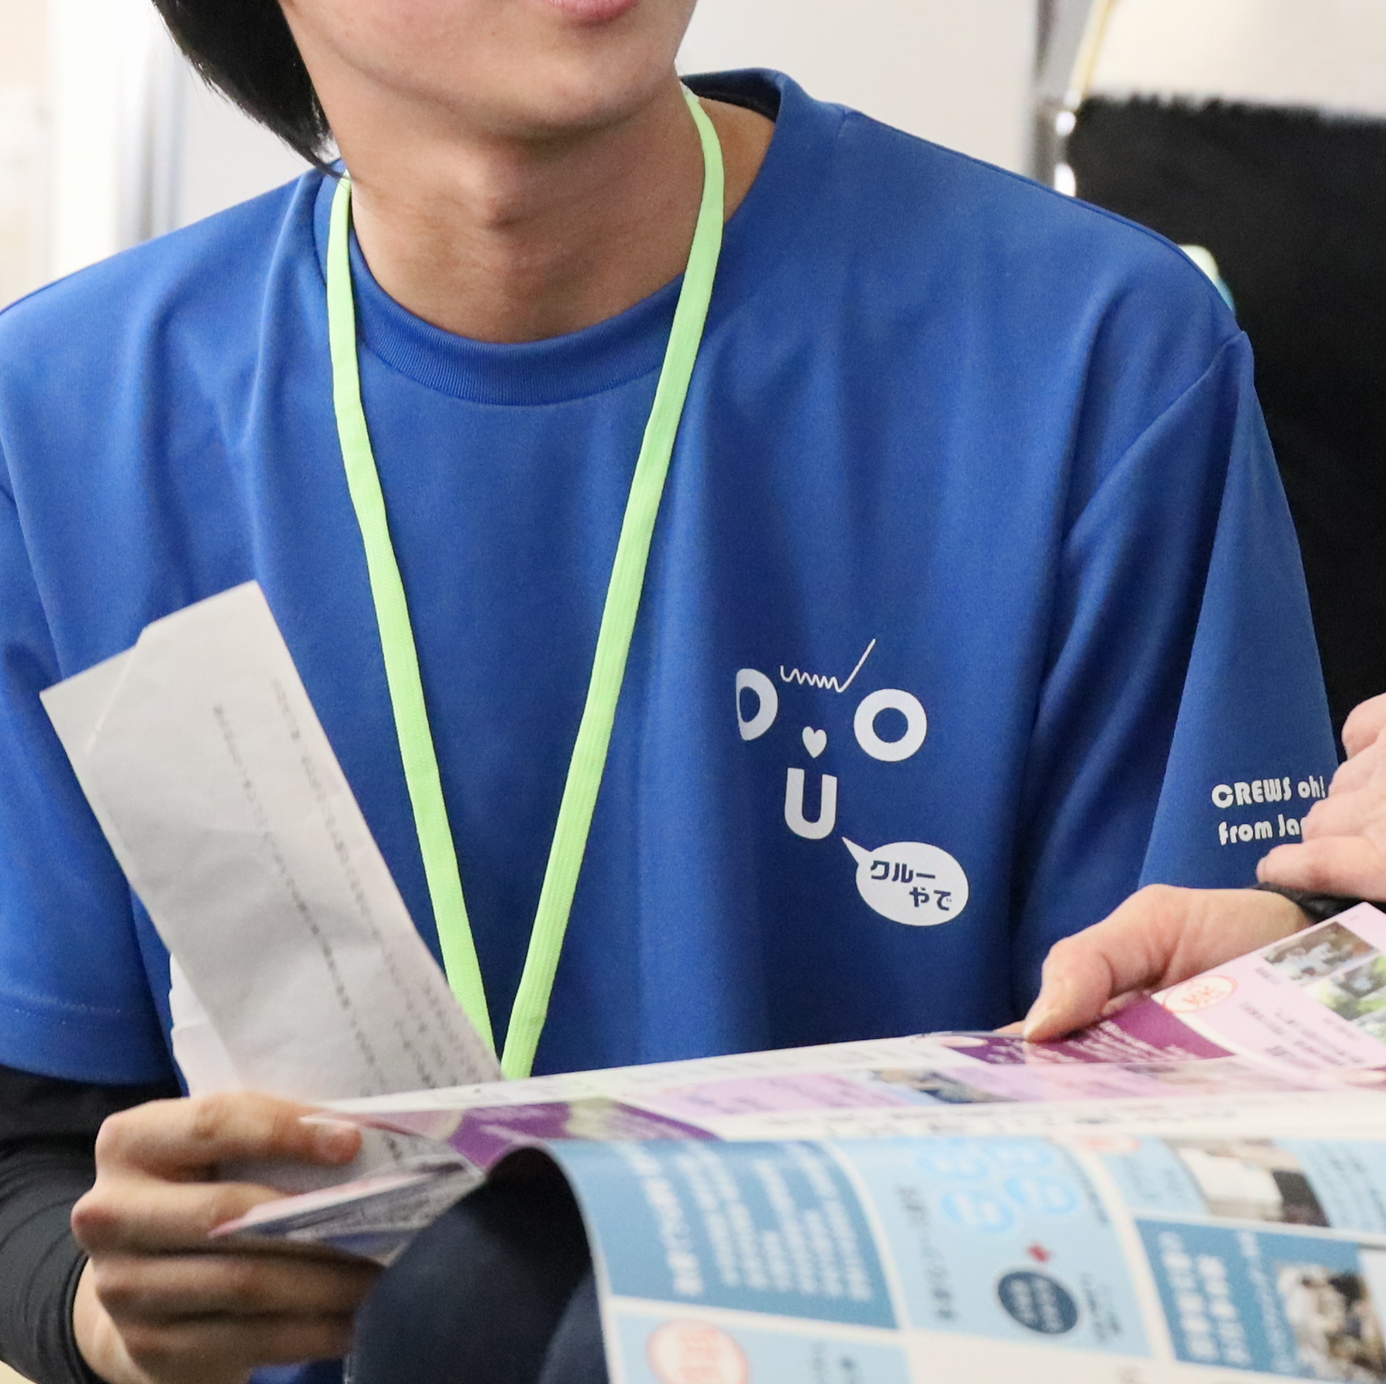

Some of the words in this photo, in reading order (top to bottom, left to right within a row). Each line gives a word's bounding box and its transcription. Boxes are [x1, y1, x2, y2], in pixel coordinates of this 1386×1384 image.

[784, 767, 838, 840] U
[1211, 776, 1293, 809] CREWS
[1218, 820, 1273, 846] from
[1277, 813, 1303, 838] Ja
[870, 860, 936, 884] クルー
[909, 886, 952, 912] やで
